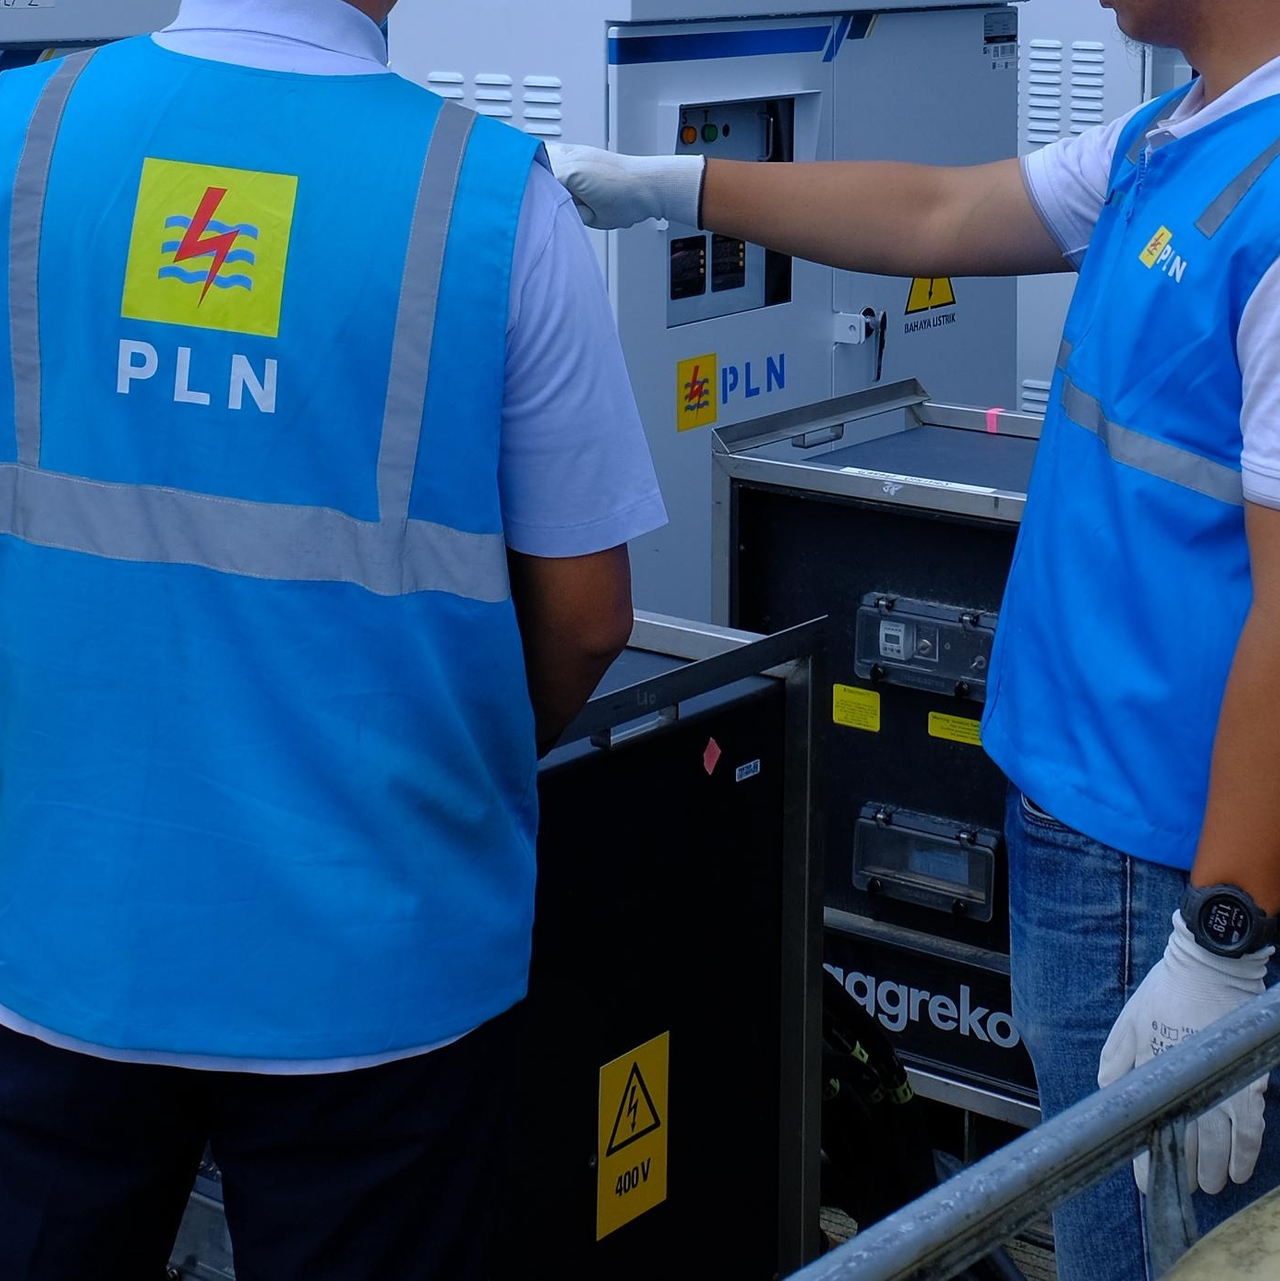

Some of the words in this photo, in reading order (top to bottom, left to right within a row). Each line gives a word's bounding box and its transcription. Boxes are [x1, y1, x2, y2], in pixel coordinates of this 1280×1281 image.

[1156, 243, 1187, 283] PLN
[904, 319, 931, 334] BAHAYA
[932, 312, 956, 327] LISTRIK
[117, 339, 278, 413] PLN
[721, 353, 786, 404] PLN
[1213, 904, 1231, 932] 11:29
[823, 963, 1020, 1048] ggreko
[616, 1166, 639, 1196] 400
[641, 1158, 651, 1182] V
